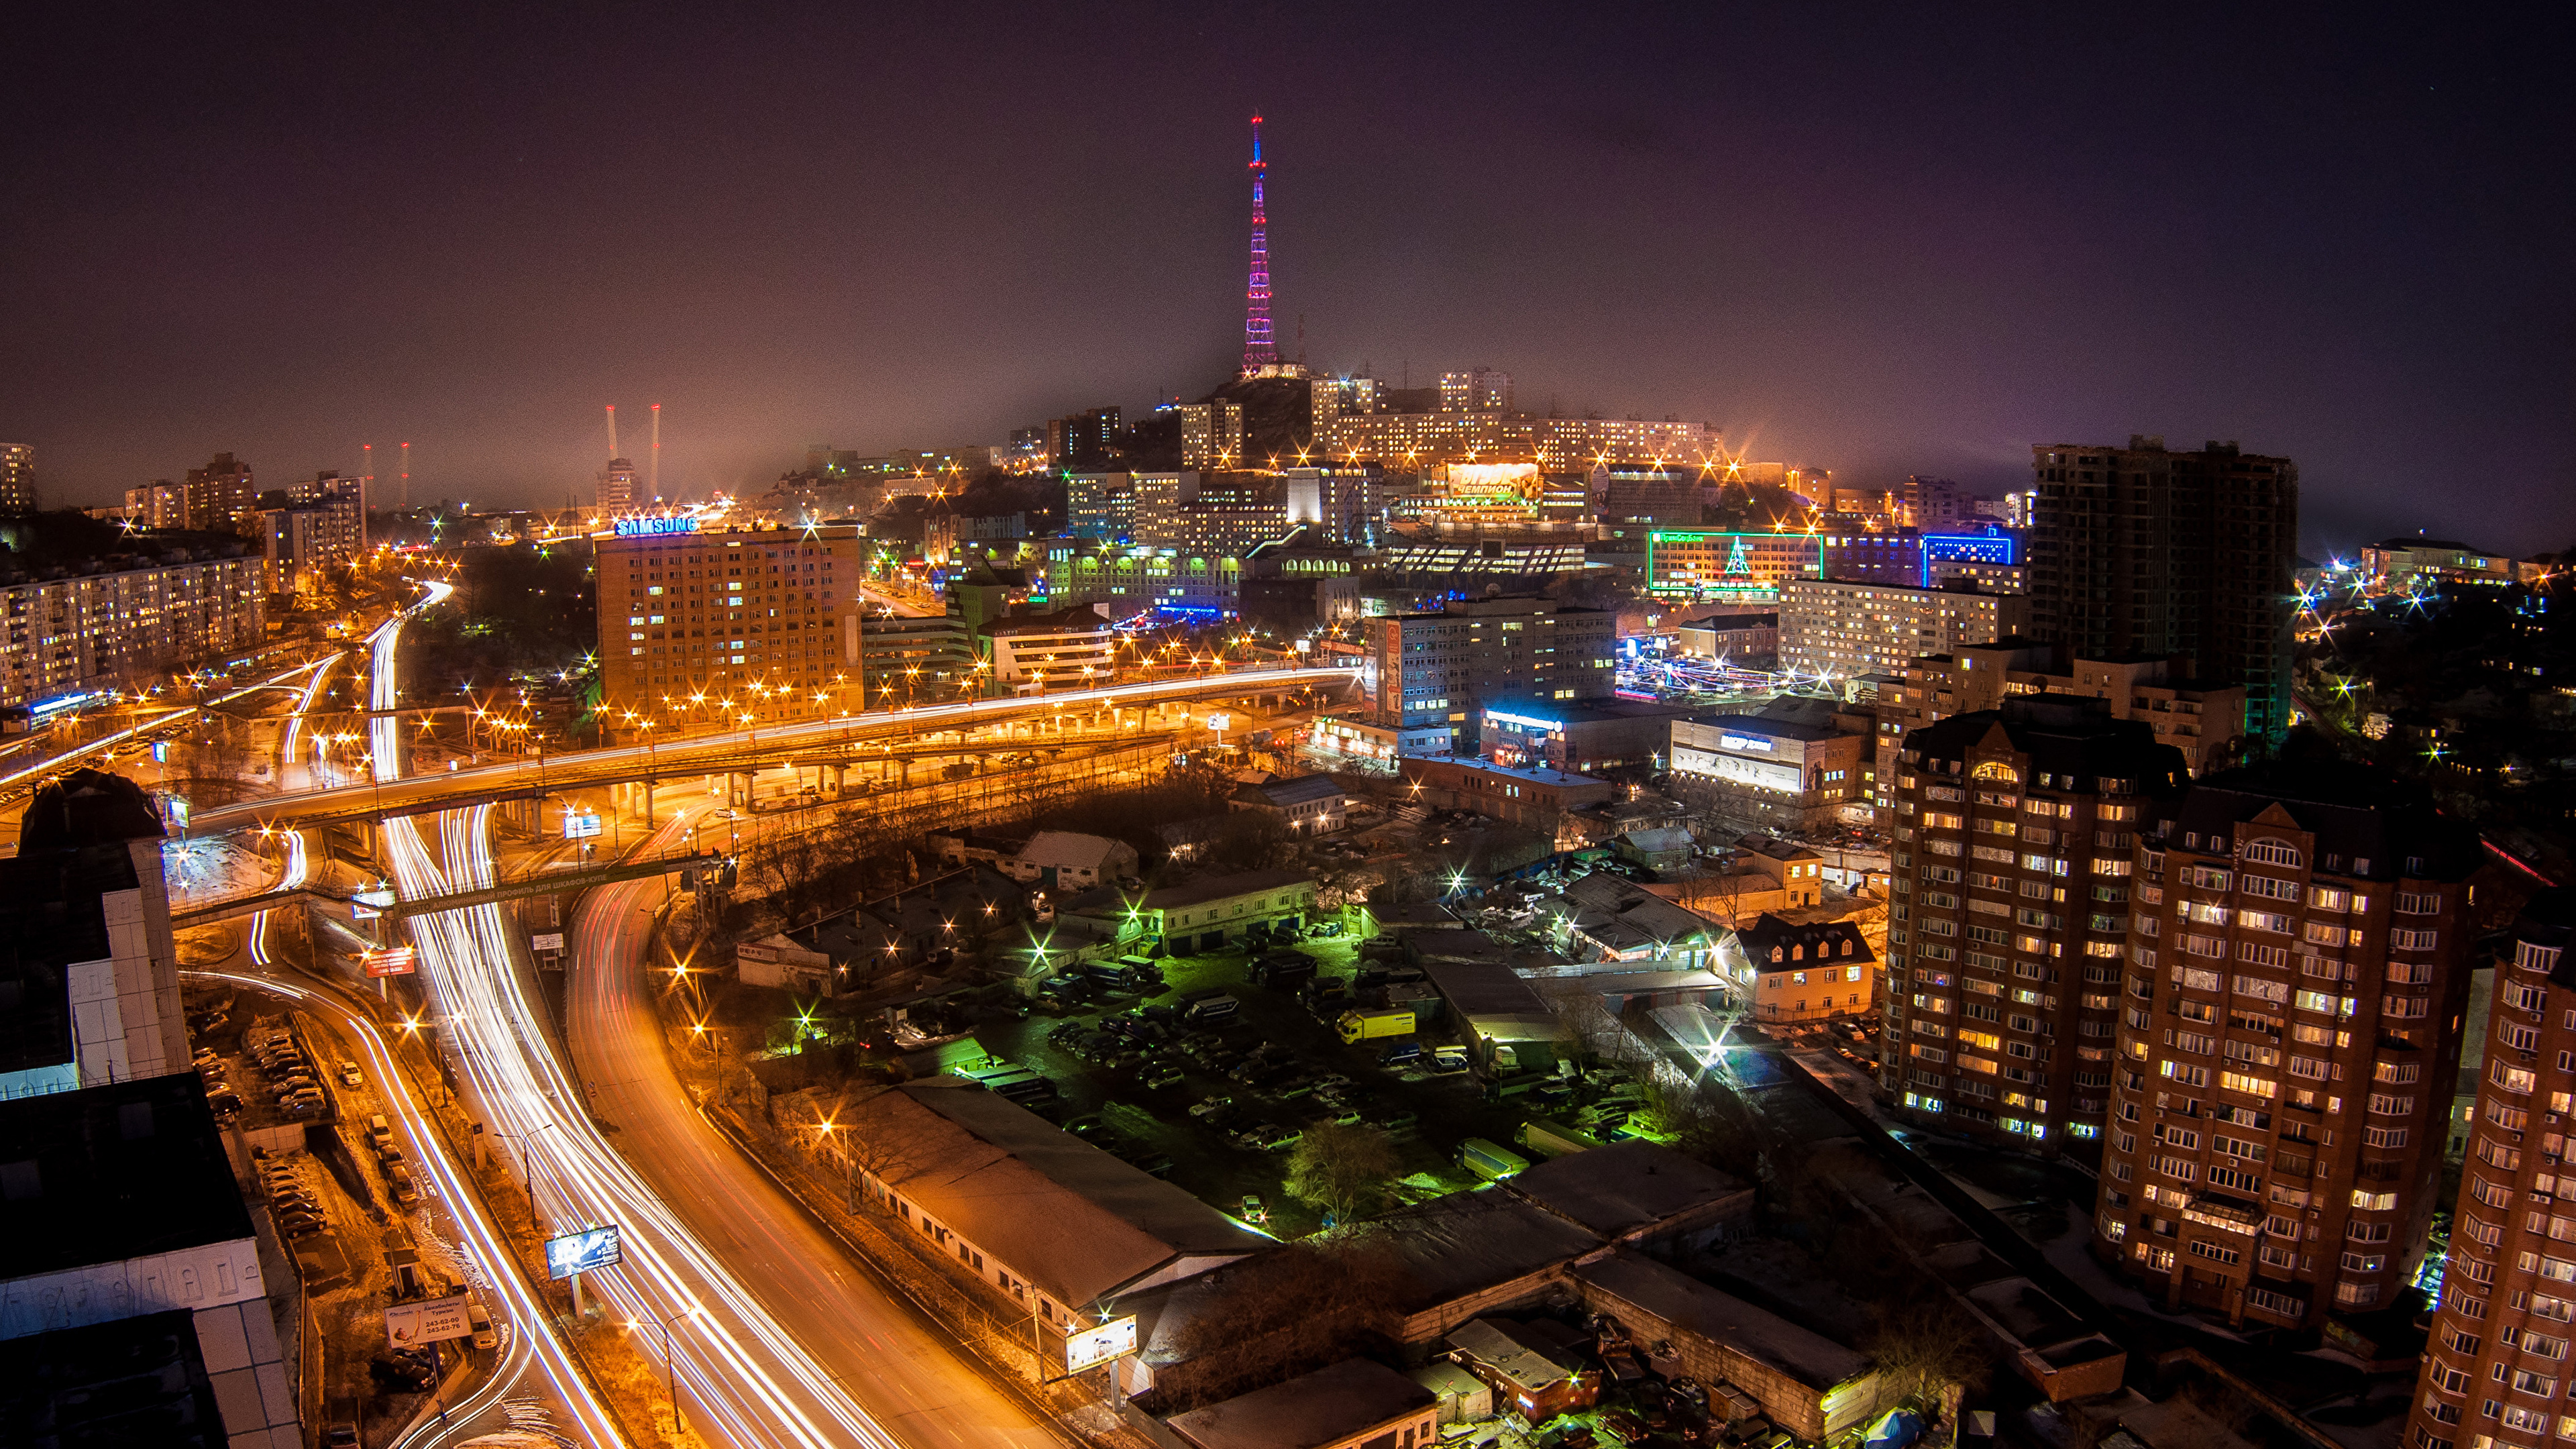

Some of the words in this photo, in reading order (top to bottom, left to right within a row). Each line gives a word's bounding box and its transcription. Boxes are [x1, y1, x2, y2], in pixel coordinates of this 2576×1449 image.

[1458, 485, 1512, 494] ЧЕМПИОН
[617, 517, 698, 535] SAMSUNG
[433, 892, 496, 910] АЛЮМИНИЕВЫЙ
[496, 885, 535, 899] ПРОФИЛЬ
[535, 882, 551, 894] ДЛЯ
[552, 873, 607, 890] ШКАФОВ-КУПЕ
[398, 902, 431, 916] ARISTO
[424, 1301, 460, 1311] Авиабилеты
[431, 1308, 454, 1316] Туризм
[425, 1317, 460, 1328] 243-62-00
[427, 1324, 460, 1334] 243-62-76
